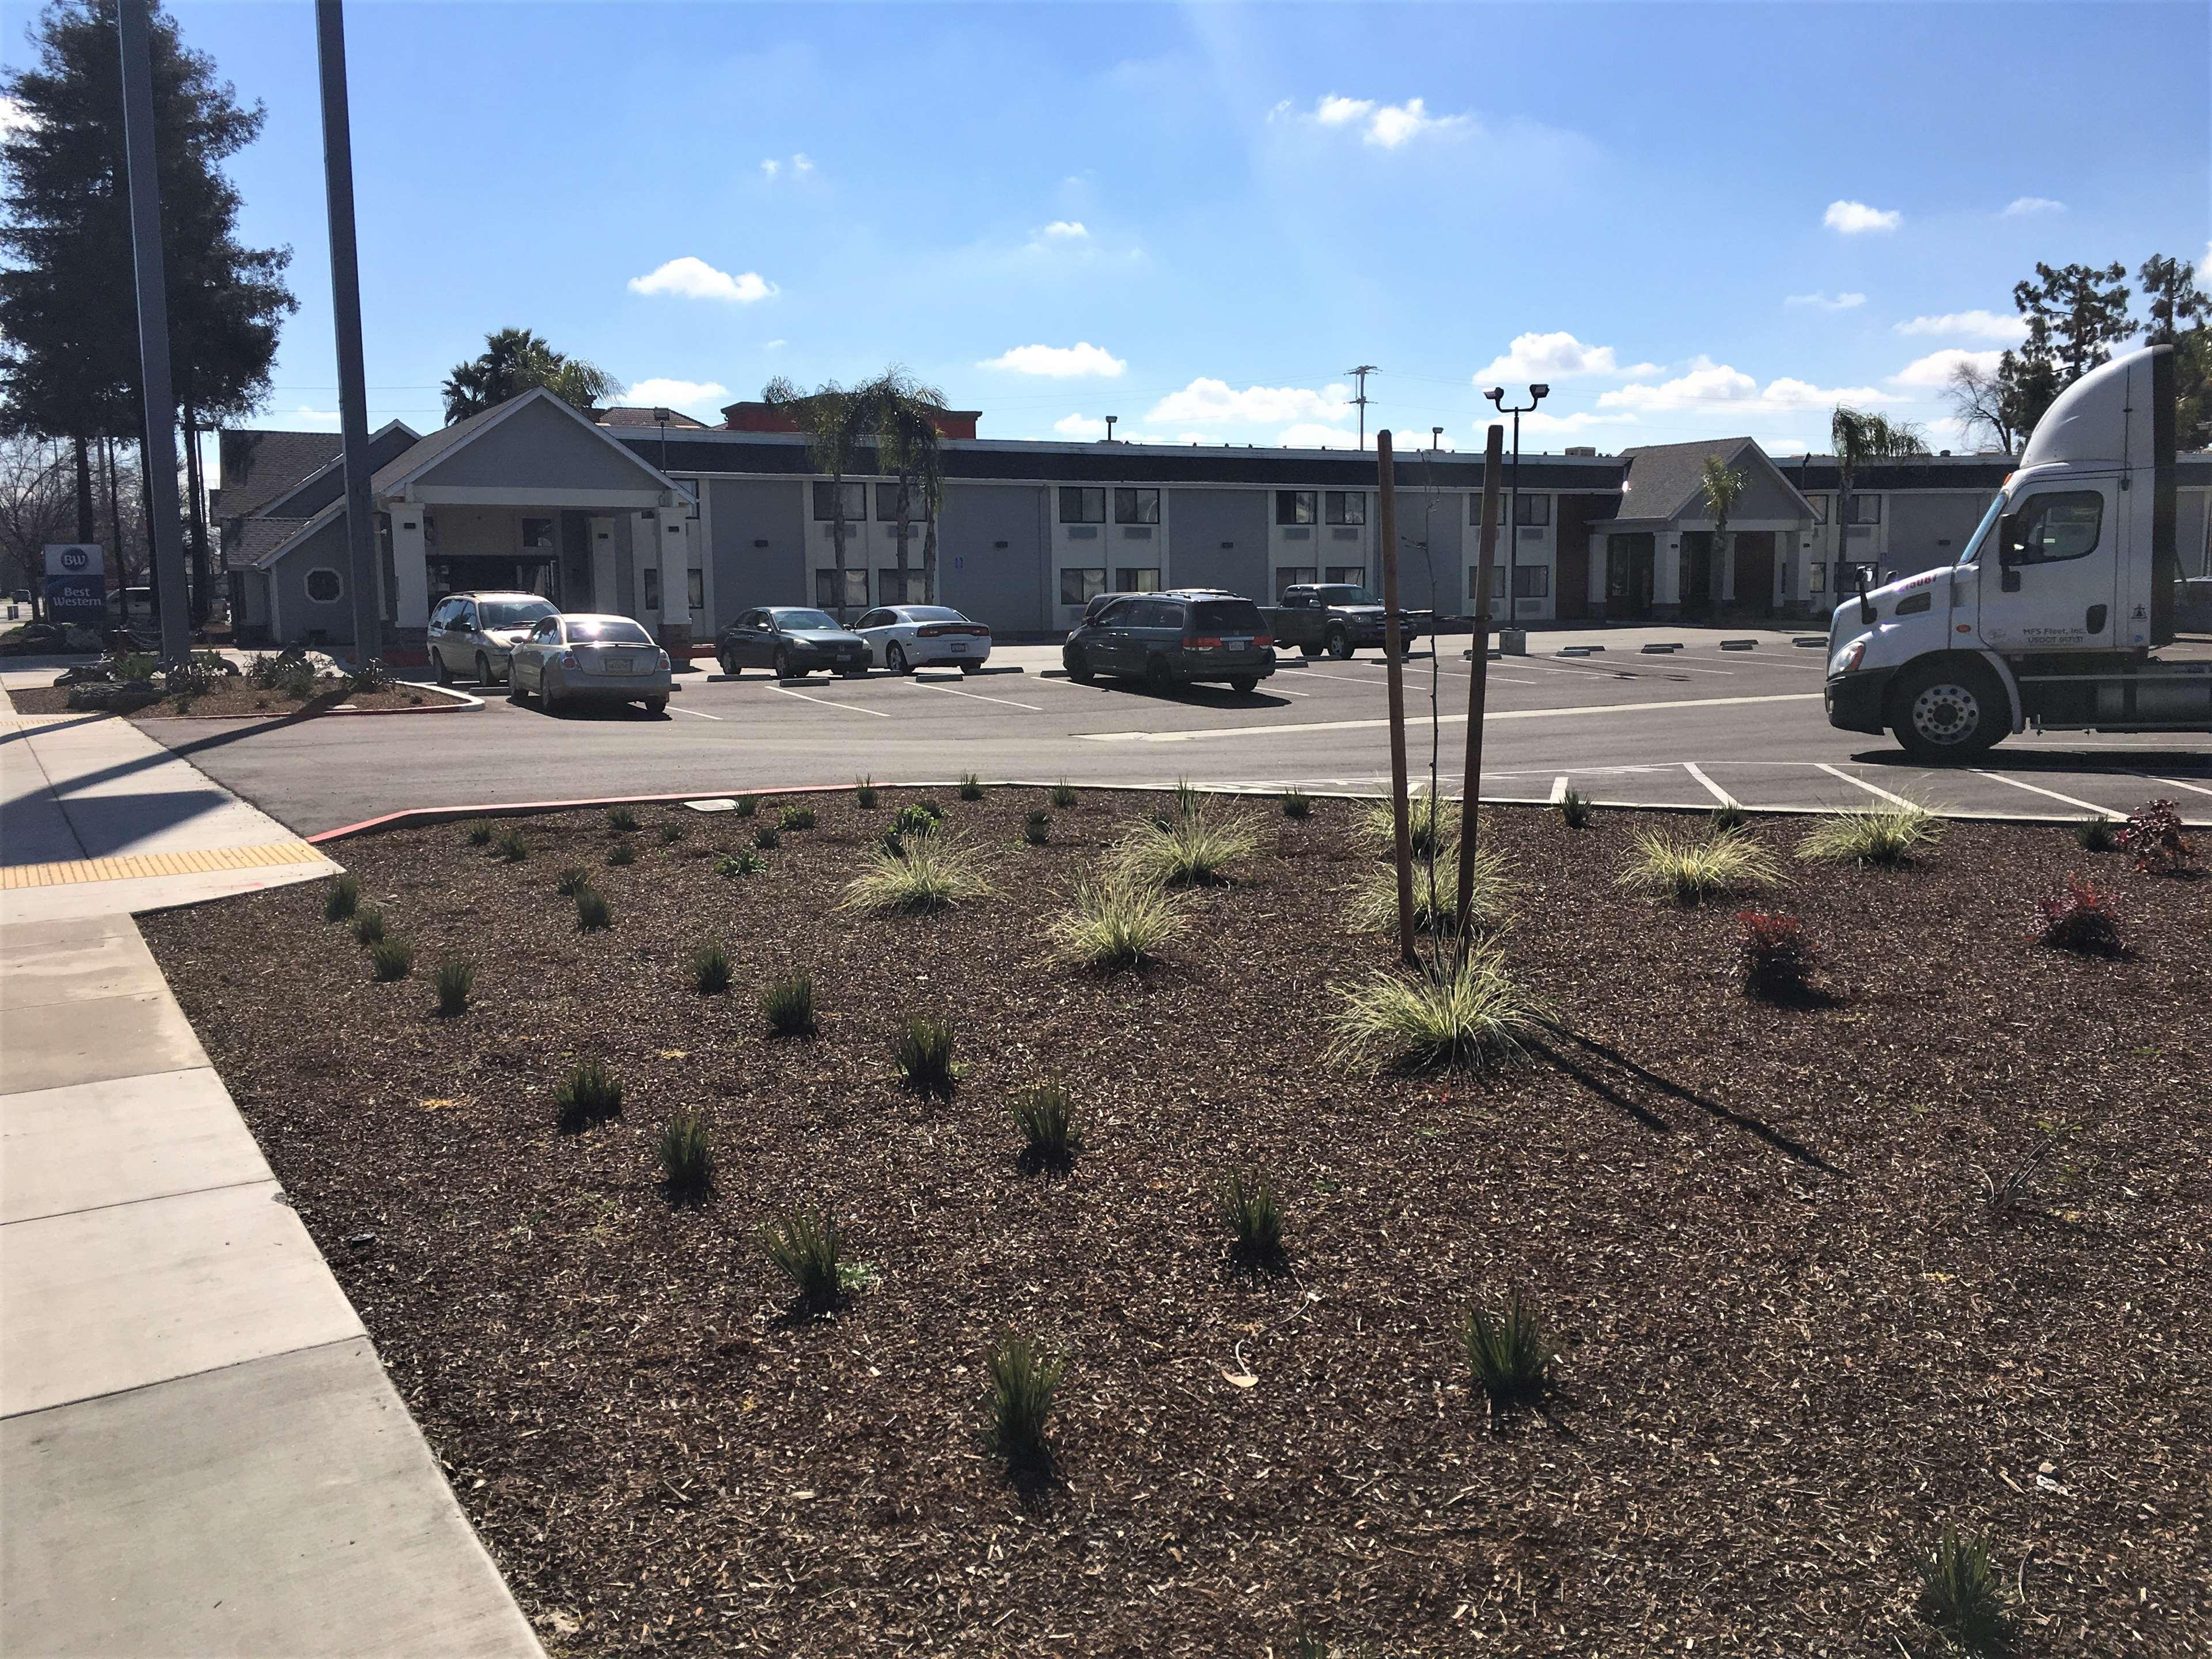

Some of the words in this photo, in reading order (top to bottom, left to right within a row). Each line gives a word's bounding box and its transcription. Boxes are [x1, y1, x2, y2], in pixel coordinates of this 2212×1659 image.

[64, 555, 86, 566] BW
[64, 587, 90, 597] Best
[52, 597, 102, 607] Western
